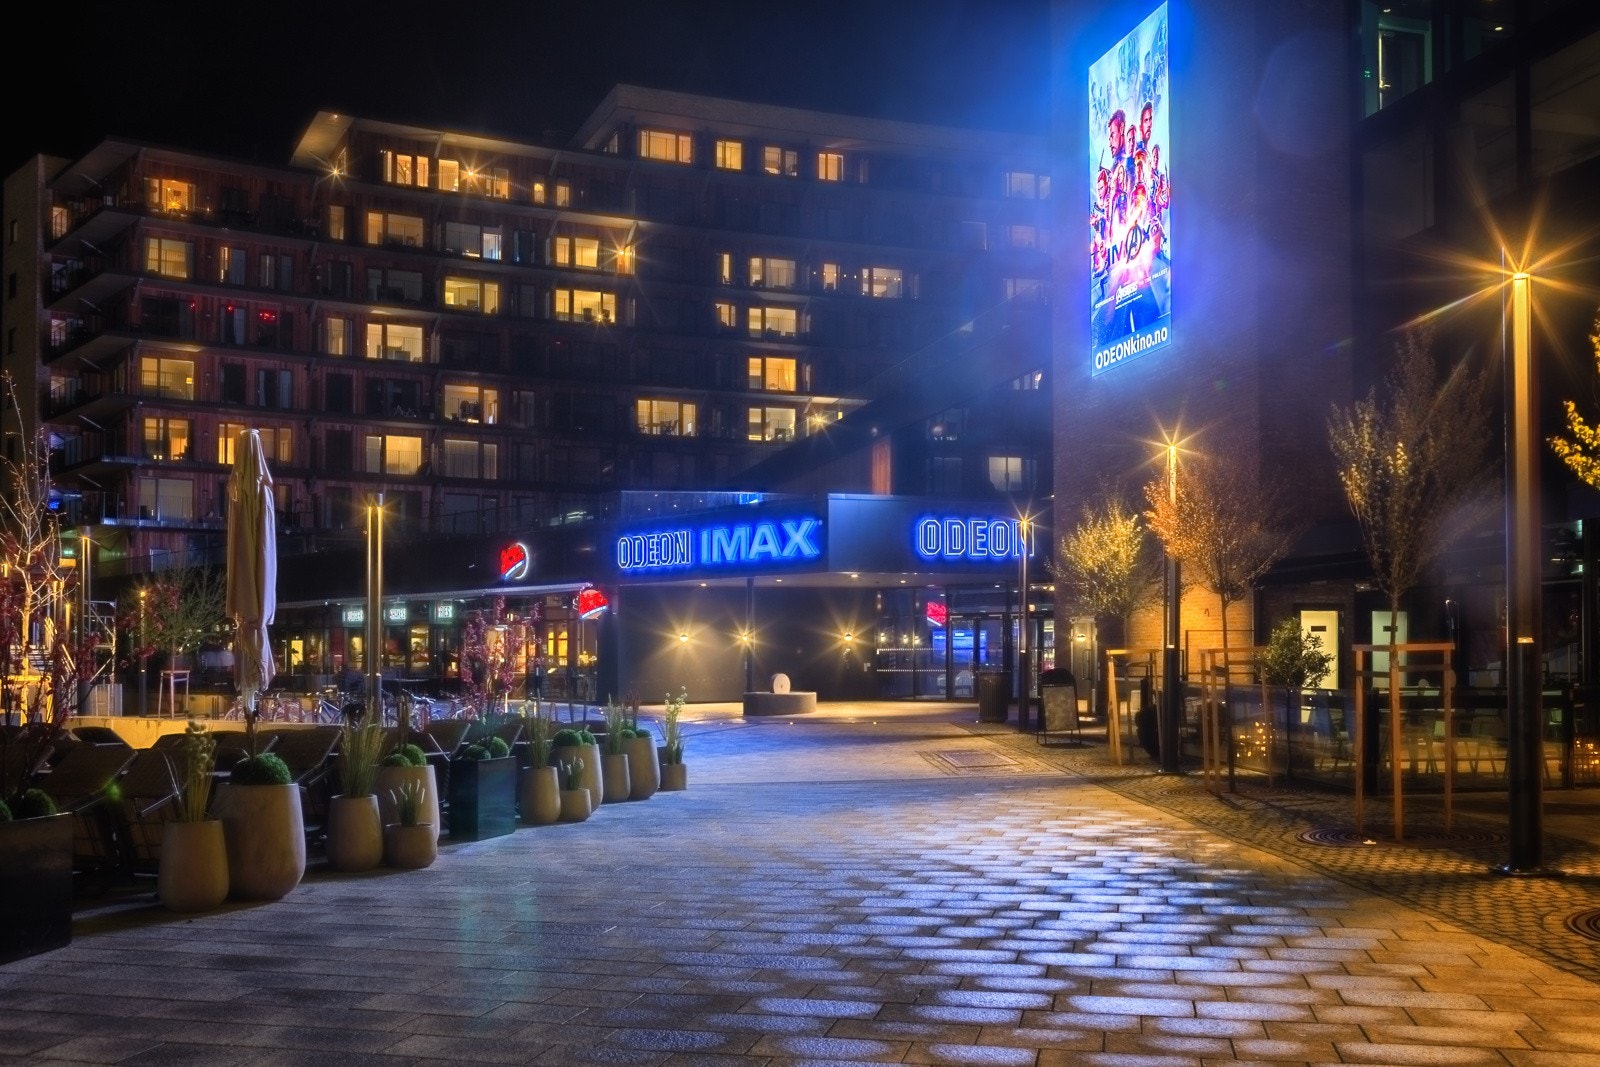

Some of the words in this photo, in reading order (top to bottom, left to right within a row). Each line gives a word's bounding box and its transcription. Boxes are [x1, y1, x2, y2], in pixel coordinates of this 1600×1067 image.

[1095, 327, 1168, 369] ODEONkino.no
[617, 531, 691, 569] ODEON
[701, 520, 819, 562] IMAX
[919, 519, 1034, 556] ODEON
